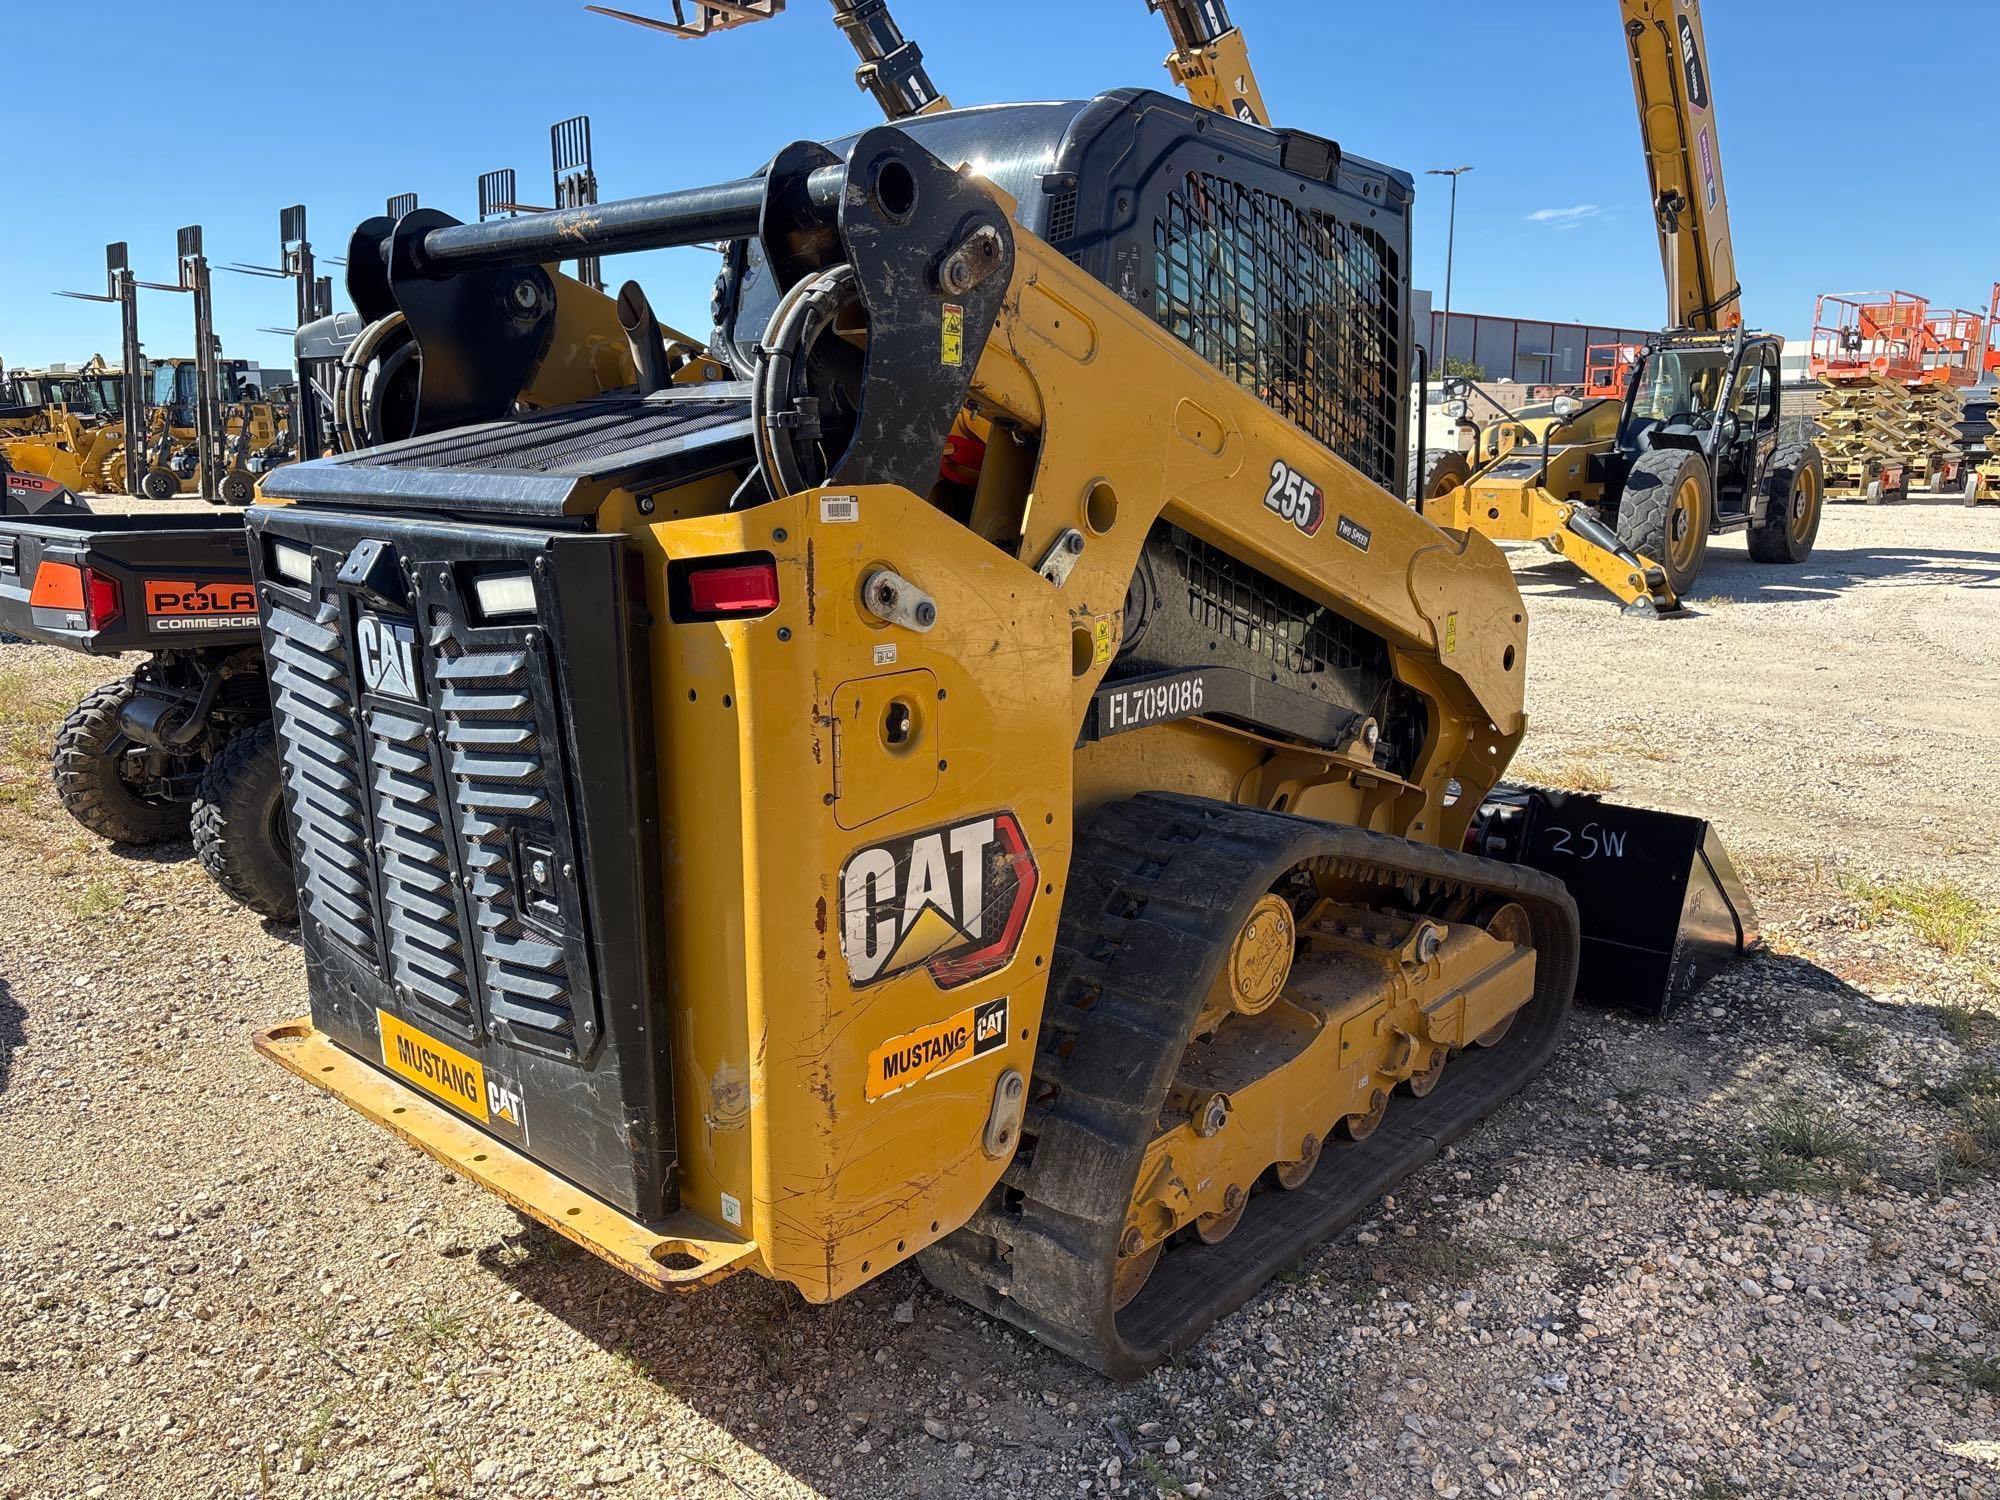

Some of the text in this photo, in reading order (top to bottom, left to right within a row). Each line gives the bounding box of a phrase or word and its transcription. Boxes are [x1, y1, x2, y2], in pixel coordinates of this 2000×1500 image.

[1681, 25, 1694, 63] CAT
[10, 477, 43, 489] PRO
[1265, 461, 1315, 527] 255
[357, 618, 417, 699] CAT
[1109, 678, 1204, 728] FL709086
[844, 818, 995, 981] CAT
[882, 1008, 1004, 1081] MUSTANG CAT
[396, 1034, 520, 1127] MUSTANG CAT
